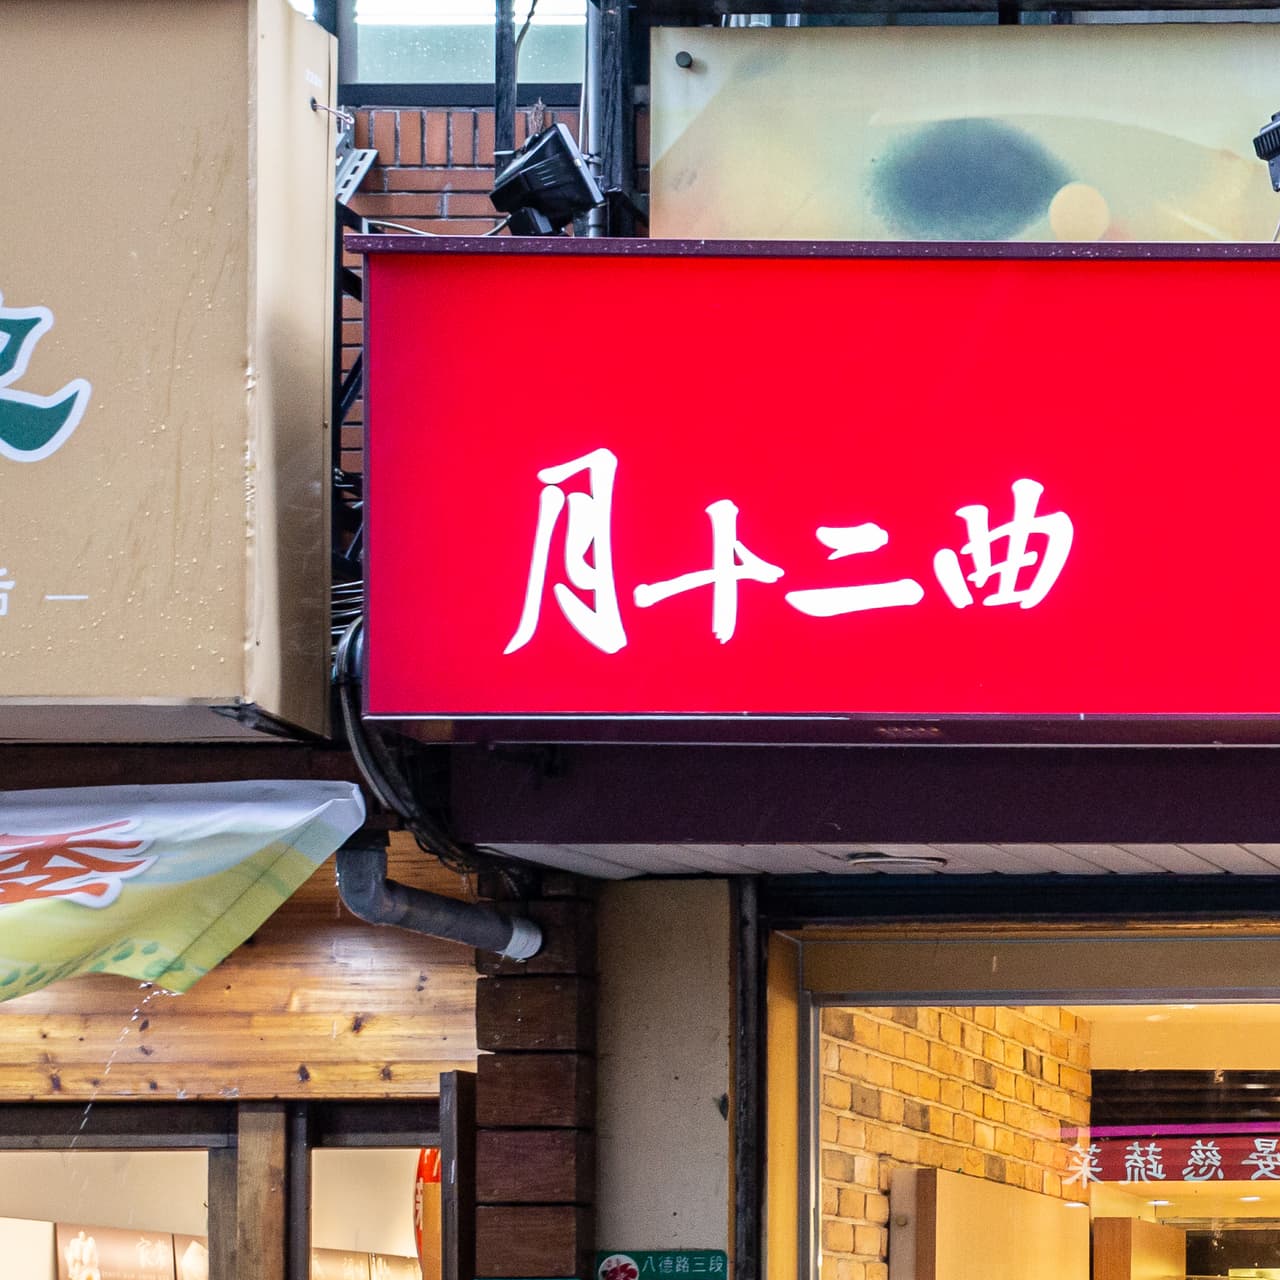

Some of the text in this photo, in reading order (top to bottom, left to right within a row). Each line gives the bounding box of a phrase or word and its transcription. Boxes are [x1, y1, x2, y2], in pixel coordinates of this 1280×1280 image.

[502, 447, 1075, 655] 月十二曲
[642, 1255, 725, 1273] 八德路三段
